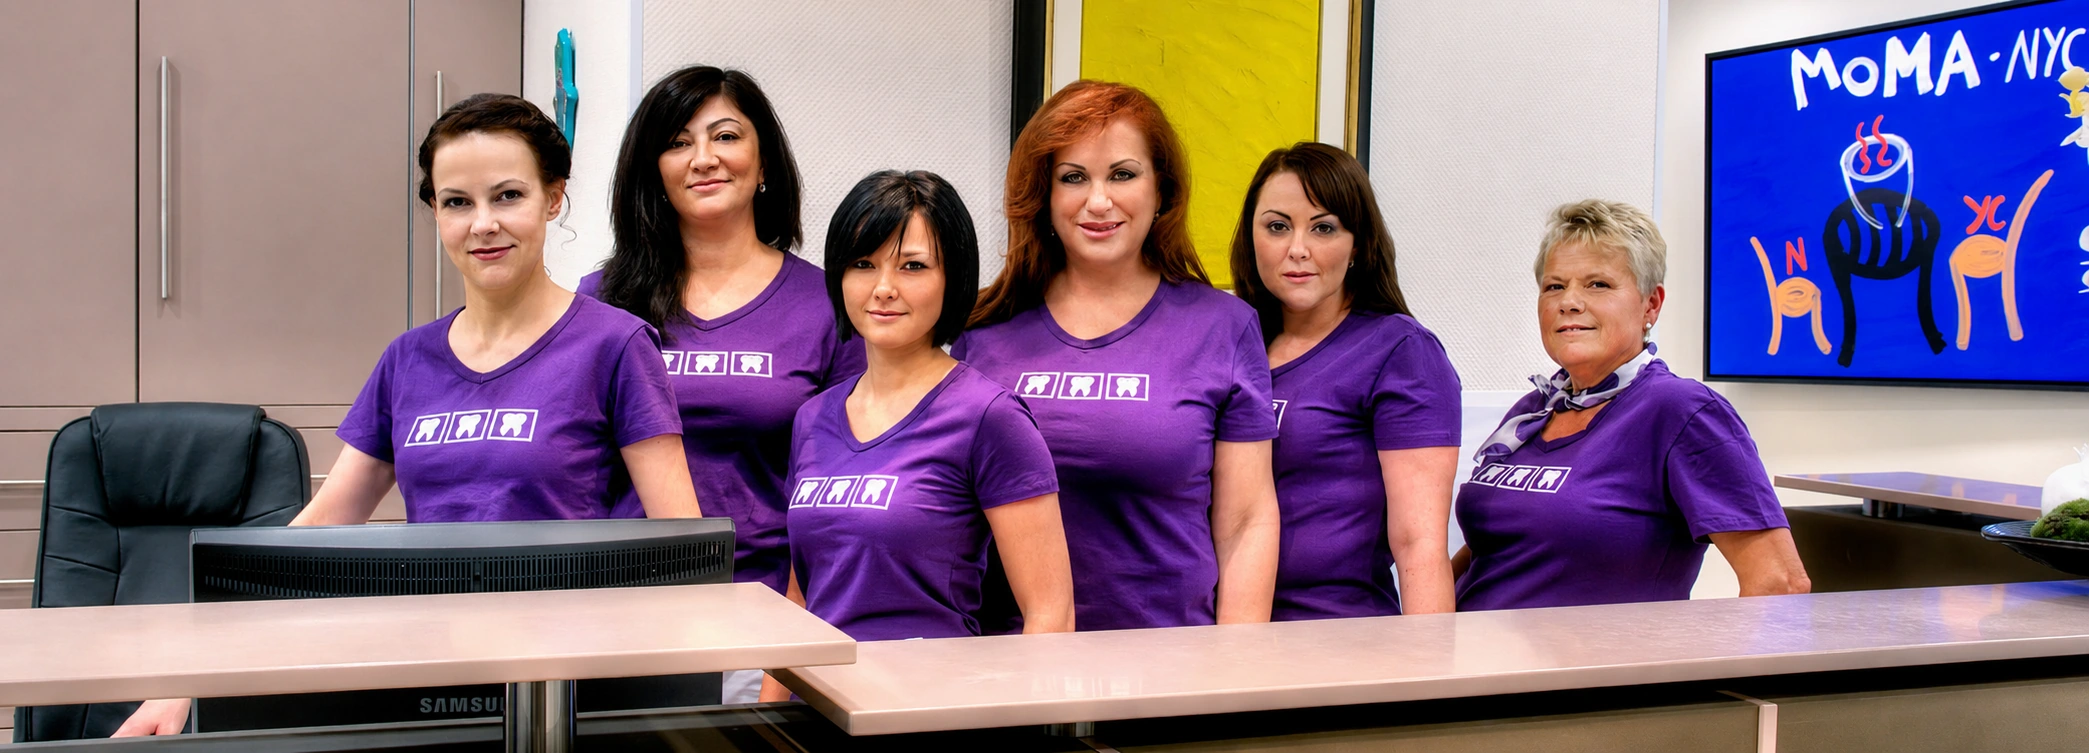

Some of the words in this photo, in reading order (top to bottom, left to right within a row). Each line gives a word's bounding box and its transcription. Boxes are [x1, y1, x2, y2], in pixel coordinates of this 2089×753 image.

[1791, 30, 1980, 111] MoMA
[1785, 237, 1808, 276] N
[419, 697, 504, 713] SAMSU
